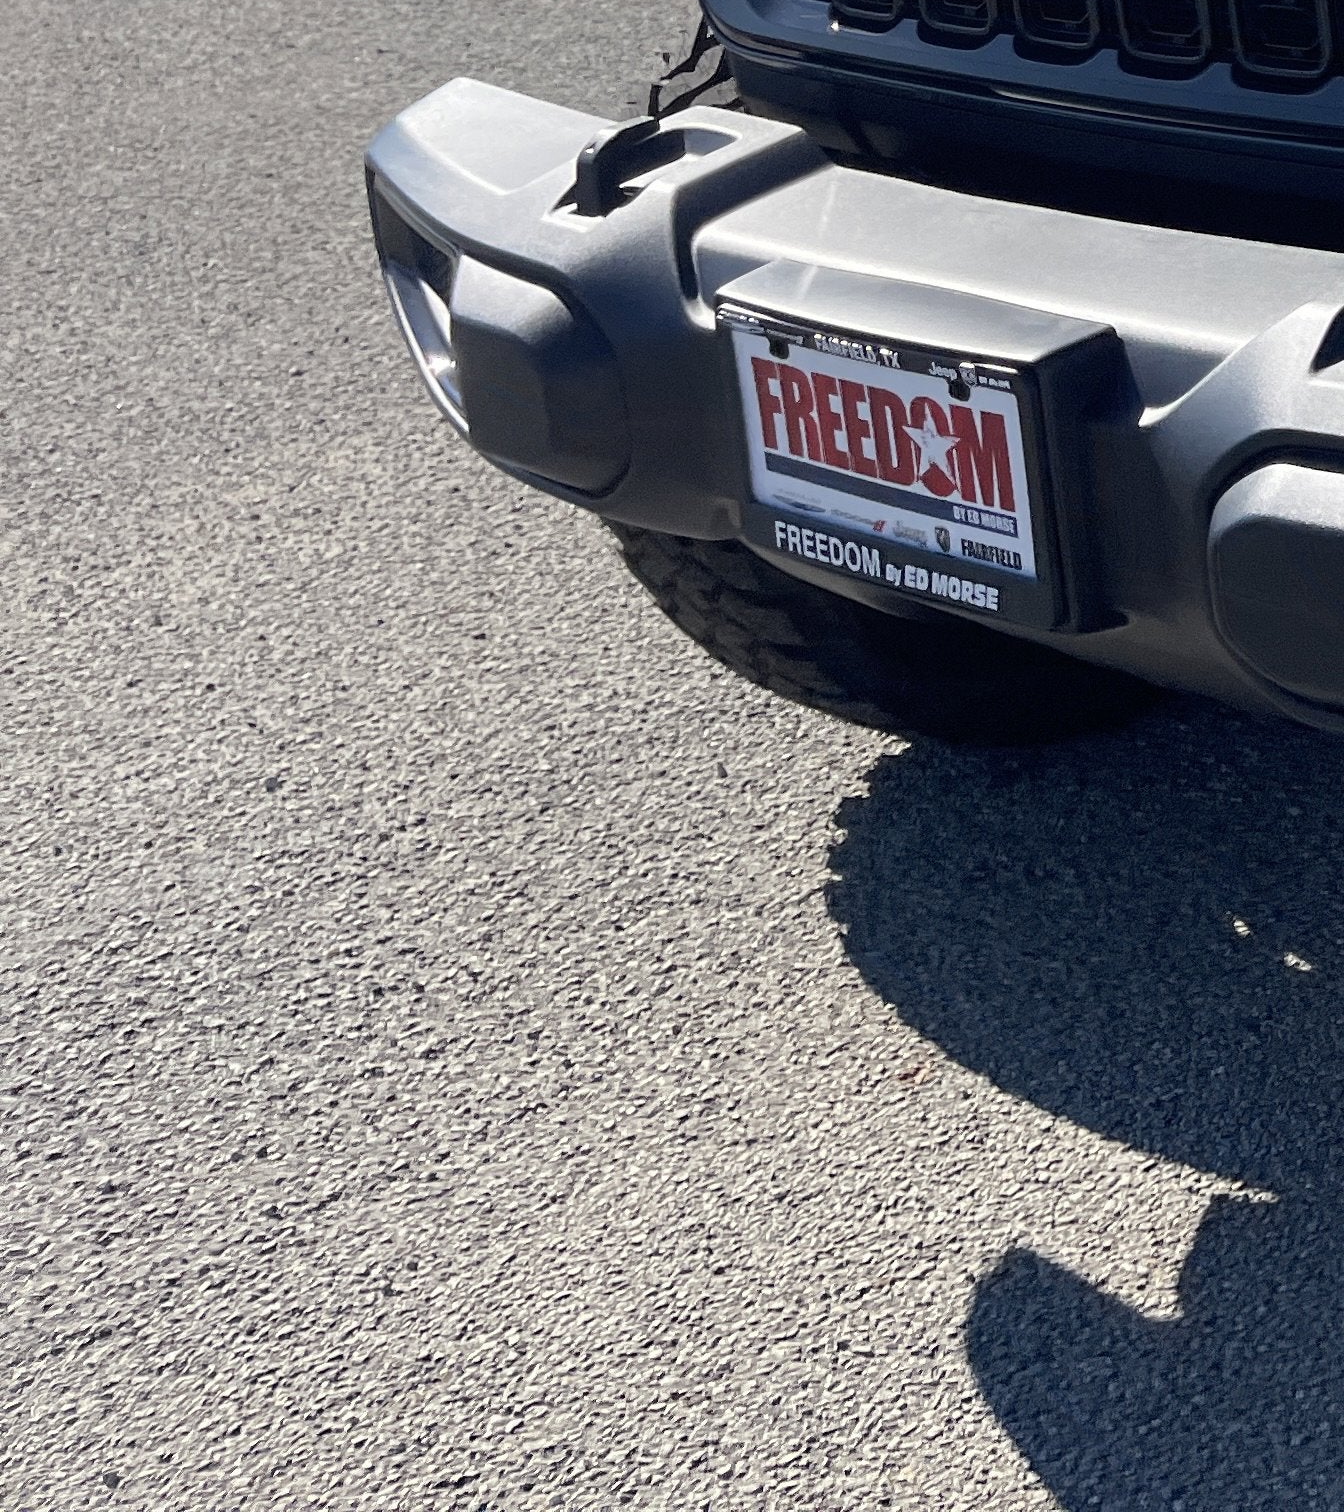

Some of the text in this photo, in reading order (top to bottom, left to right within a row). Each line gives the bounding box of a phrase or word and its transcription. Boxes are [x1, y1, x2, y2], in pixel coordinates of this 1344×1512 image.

[751, 356, 1016, 512] FREEDOM
[774, 520, 881, 578] FREEDOM
[904, 564, 930, 591] ED
[931, 571, 999, 612] MORSE
[960, 537, 1023, 571] FAIRFIELD
